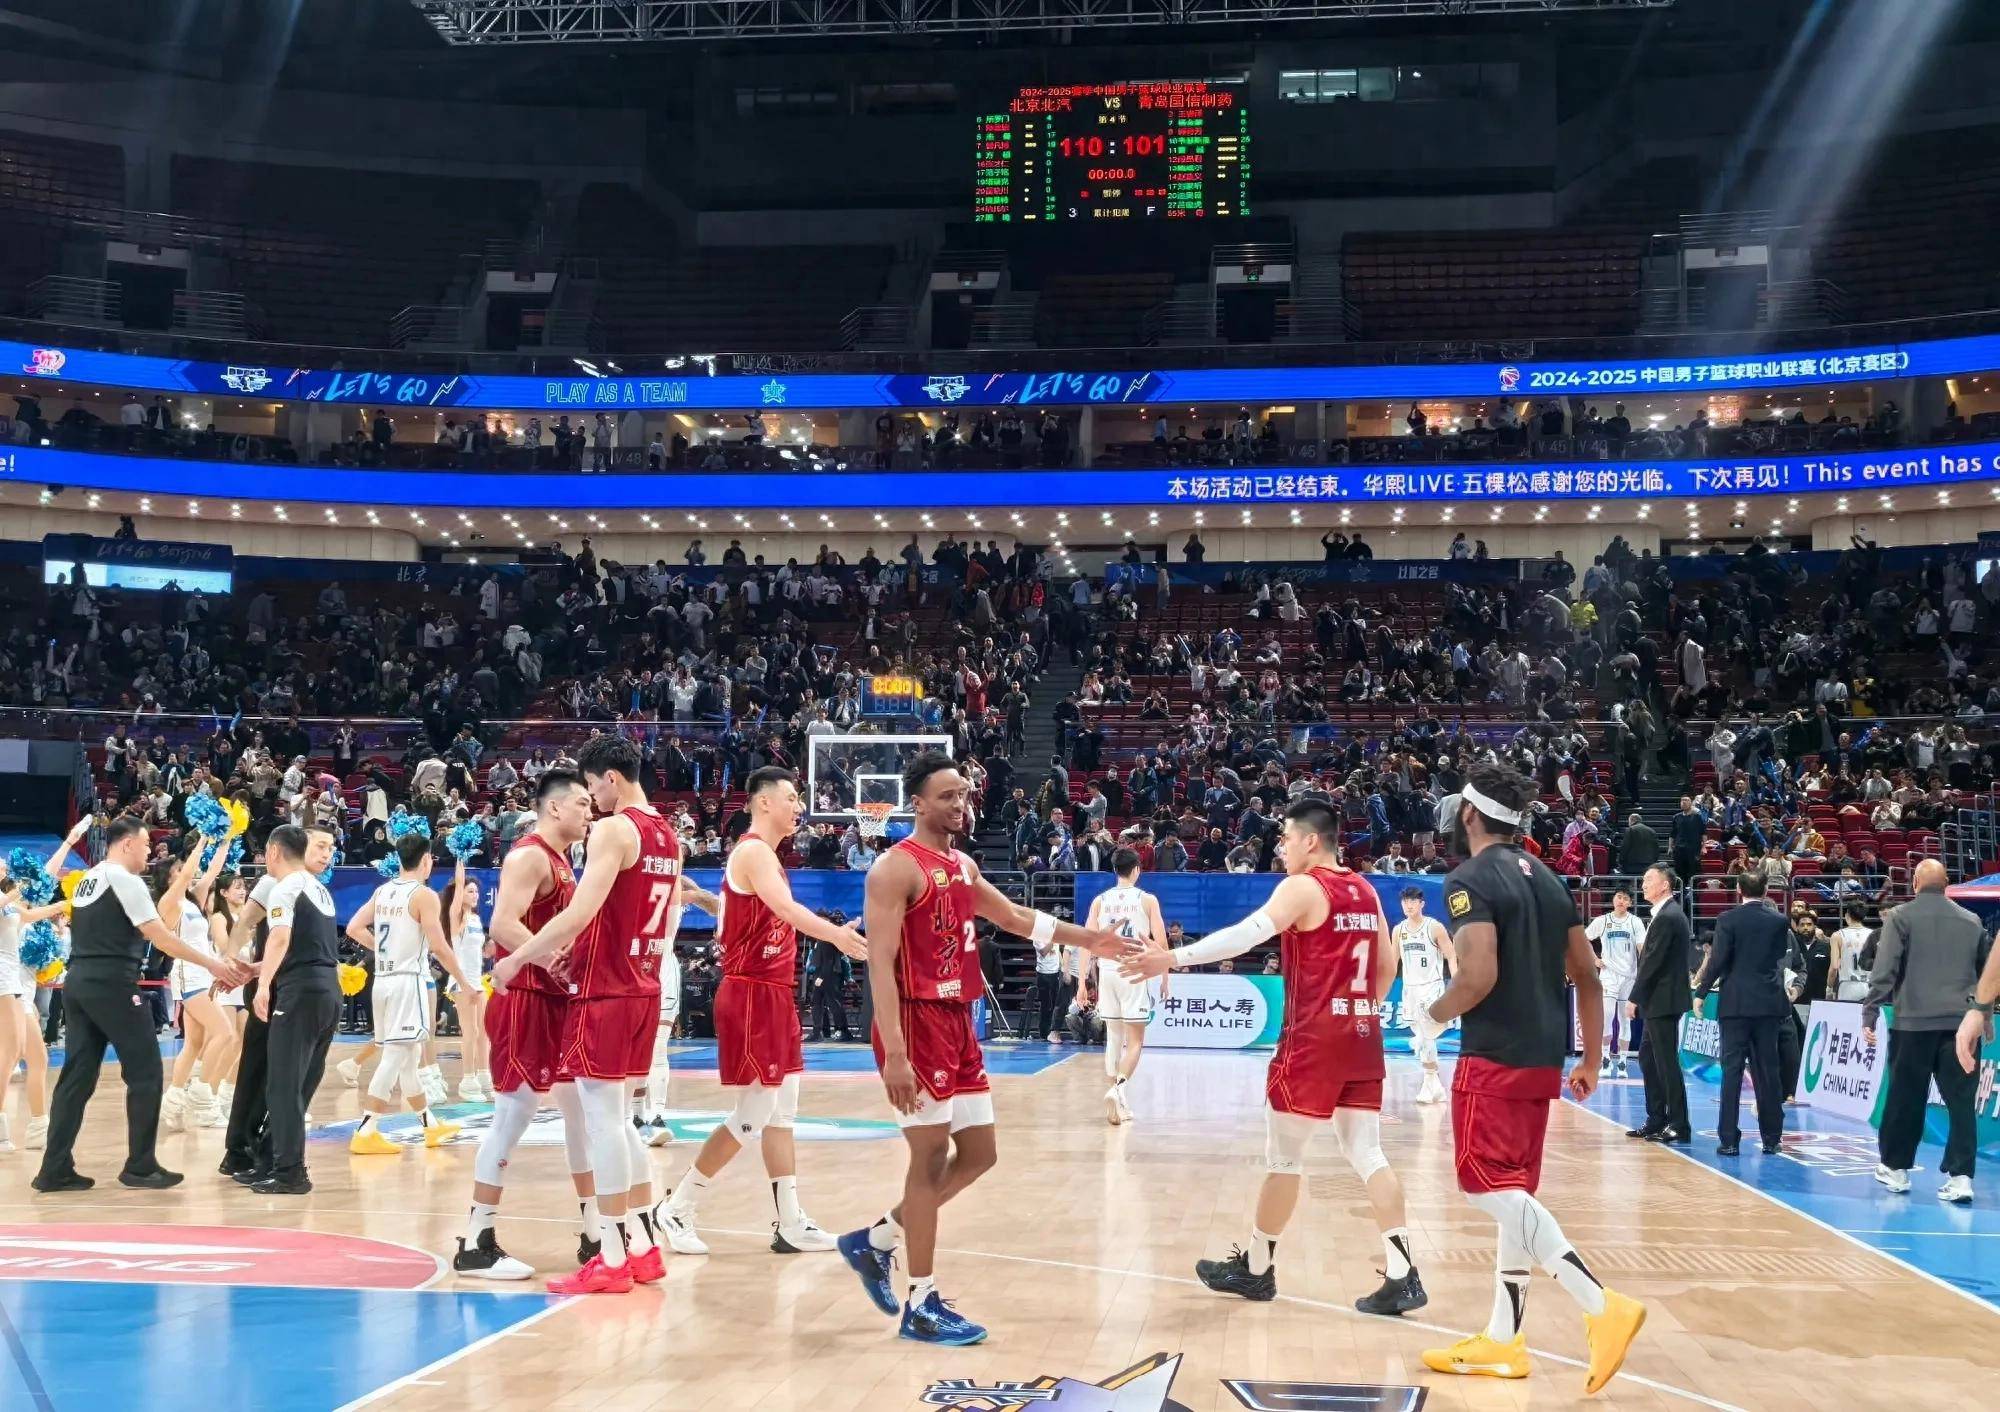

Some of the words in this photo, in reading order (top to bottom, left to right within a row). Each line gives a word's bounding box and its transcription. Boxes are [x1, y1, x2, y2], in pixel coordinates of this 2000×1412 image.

[1104, 97, 1121, 109] VS
[1060, 137, 1104, 157] 110
[1124, 135, 1165, 155] 101
[1087, 168, 1136, 180] 00:00.0
[1068, 207, 1077, 218] 3
[1147, 206, 1156, 216] F
[324, 372, 392, 401] LET'S
[396, 377, 428, 402] GO
[1018, 372, 1085, 403] LET'S
[1088, 376, 1120, 401] GO
[1530, 369, 1636, 387] 2024-2025
[546, 382, 590, 403] PLAY
[595, 382, 618, 402] AS
[623, 382, 635, 402] A
[640, 382, 687, 402] TEAM
[1803, 461, 1852, 484] This
[1863, 458, 1929, 480] event
[1941, 454, 1982, 475] has
[640, 881, 672, 934] 7
[378, 924, 391, 953] 2
[1350, 939, 1371, 992] 1
[1421, 957, 1428, 968] 8
[1164, 997, 1255, 1015] 中国人寿
[1164, 1017, 1213, 1028] CHINA
[1219, 1019, 1254, 1029] LIFE
[1823, 1072, 1847, 1095] CHINA
[1849, 1077, 1871, 1100] LIFE
